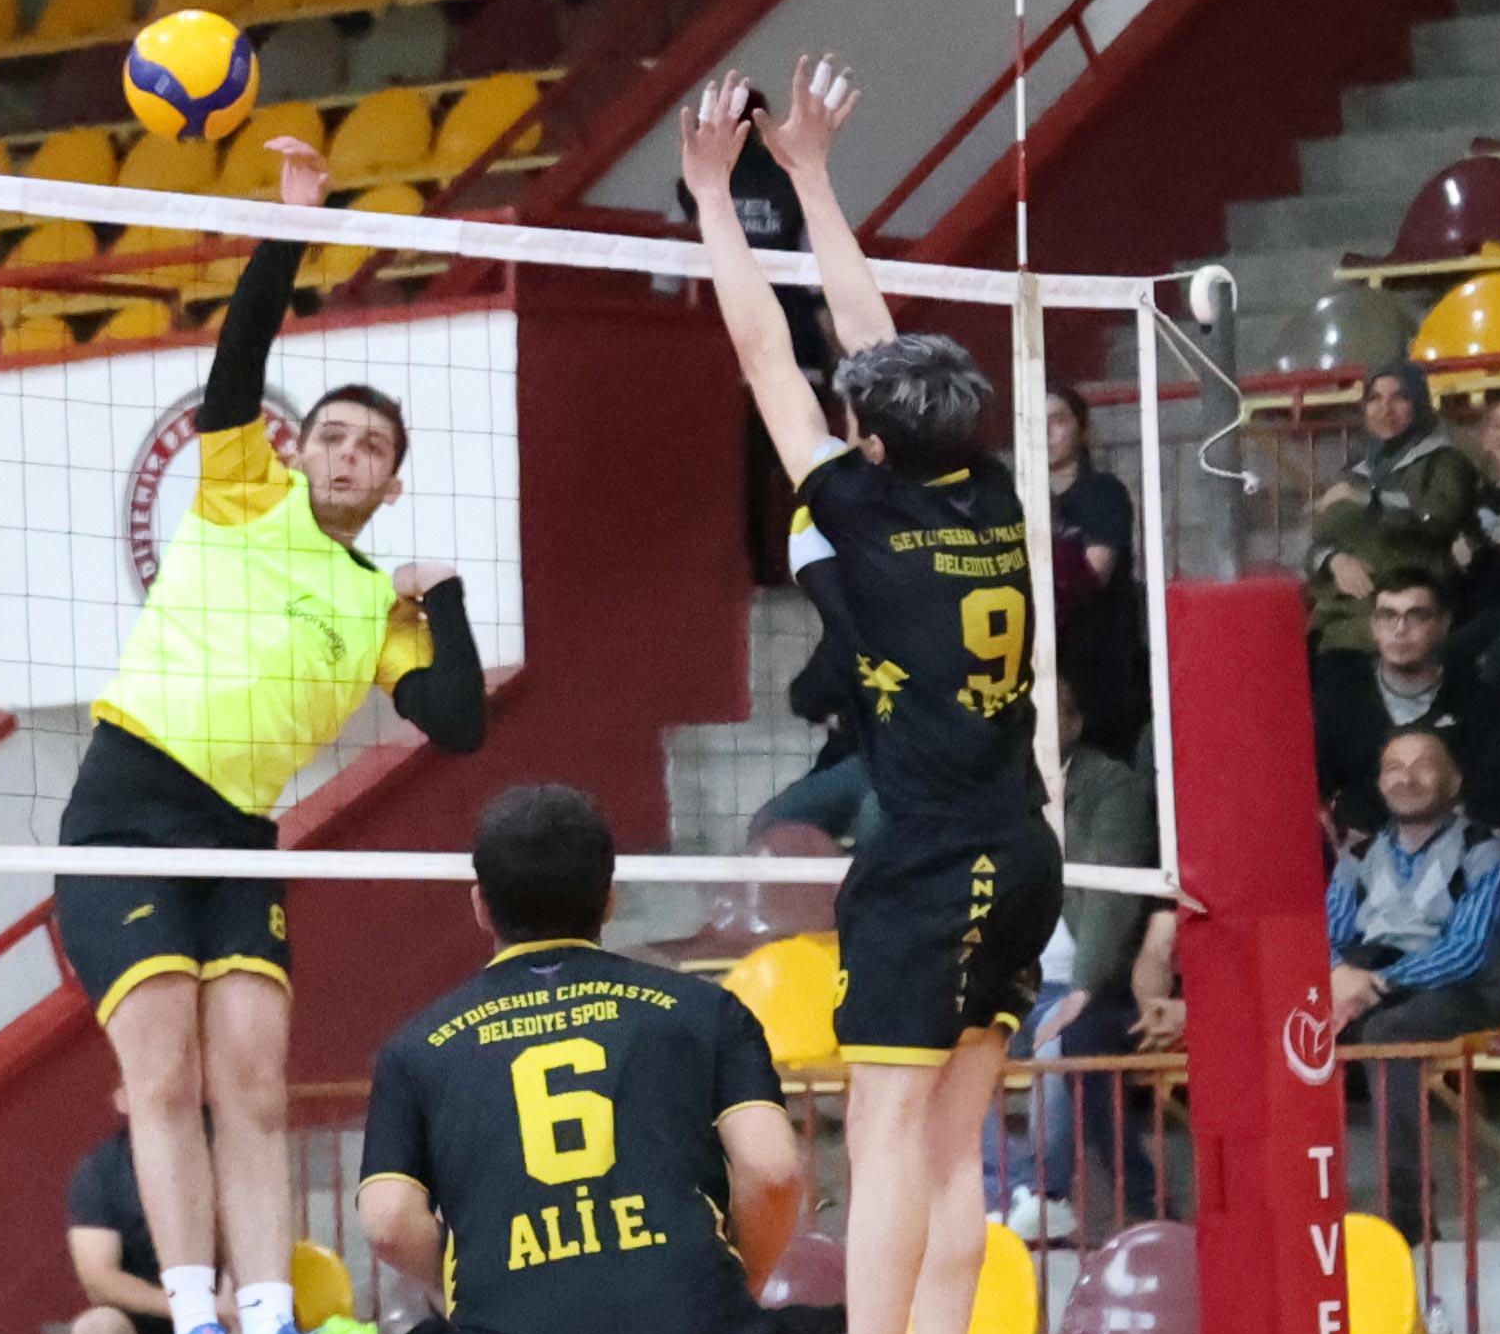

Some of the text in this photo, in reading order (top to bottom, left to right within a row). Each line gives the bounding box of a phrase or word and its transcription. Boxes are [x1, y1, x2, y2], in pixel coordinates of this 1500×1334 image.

[960, 585, 1026, 699] 9
[571, 1000, 620, 1027] SPOR
[510, 1037, 617, 1186] 6
[508, 1185, 668, 1271] ALİ E.
